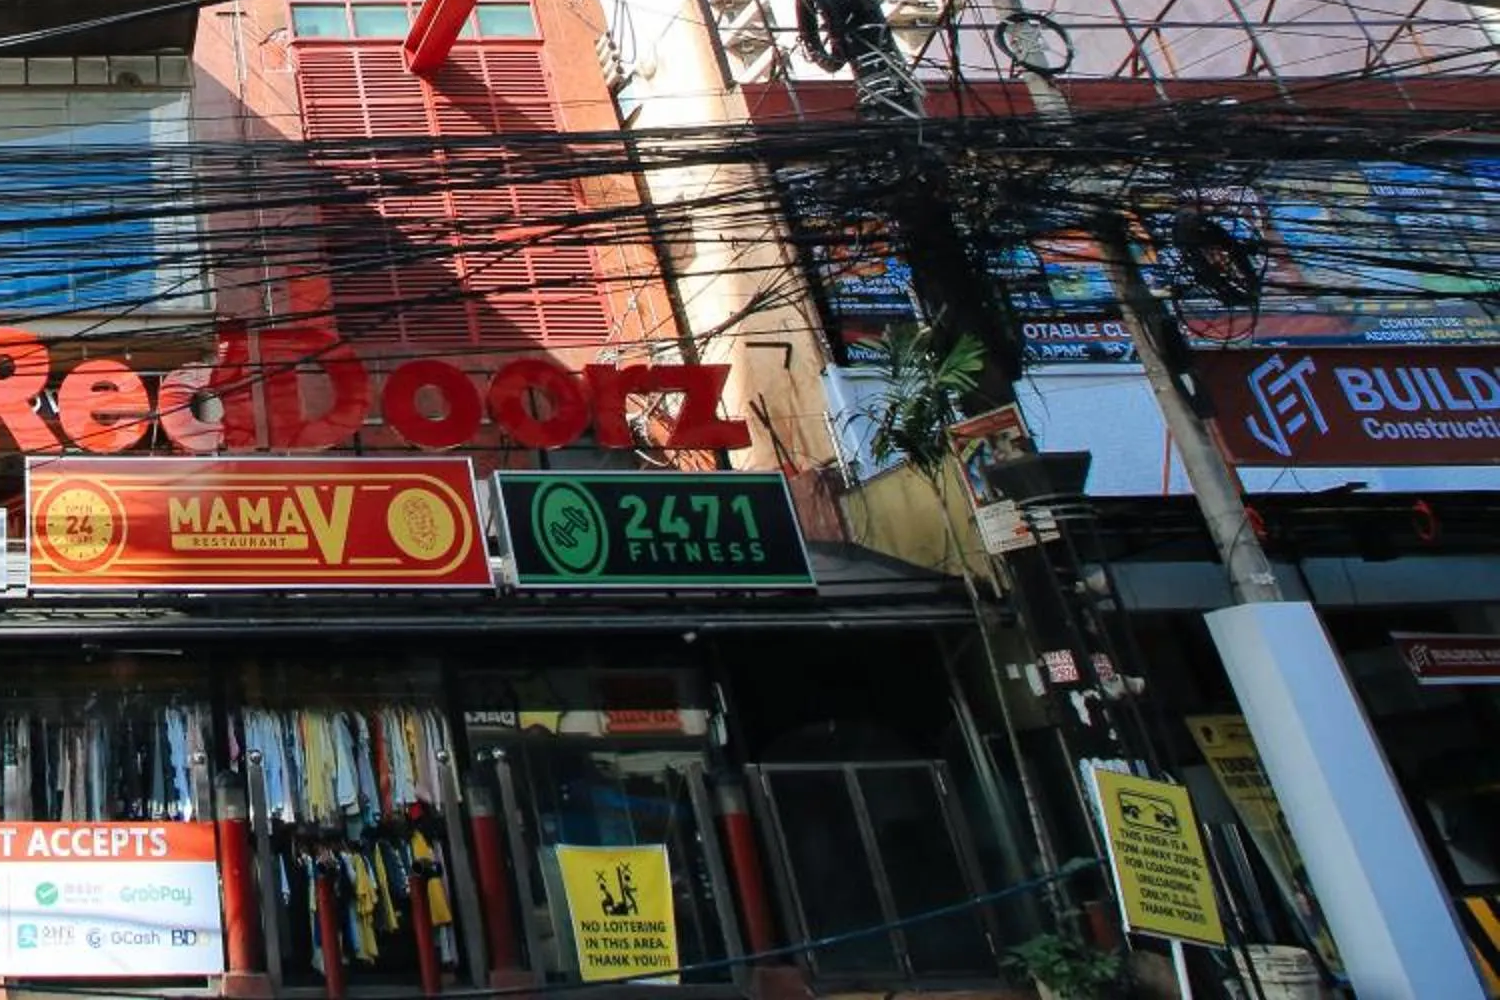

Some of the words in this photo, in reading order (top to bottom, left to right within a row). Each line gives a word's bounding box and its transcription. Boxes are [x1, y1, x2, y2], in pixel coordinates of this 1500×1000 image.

[1023, 323, 1099, 339] OTABLE
[1333, 367, 1500, 411] BUILD
[1362, 416, 1500, 439] Constructi
[65, 514, 94, 534] 24
[168, 496, 307, 534] MAMA
[295, 485, 355, 566] V
[618, 495, 760, 539] 2471
[191, 536, 289, 548] RESTAURANT
[628, 542, 767, 563] FITNESS
[27, 827, 168, 858] ACCEPTS
[580, 920, 600, 933] NO
[603, 920, 667, 933] LOITERING
[111, 929, 160, 947] GCash
[585, 937, 599, 949] IN
[602, 937, 631, 949] THIS
[588, 954, 631, 967] THANK
